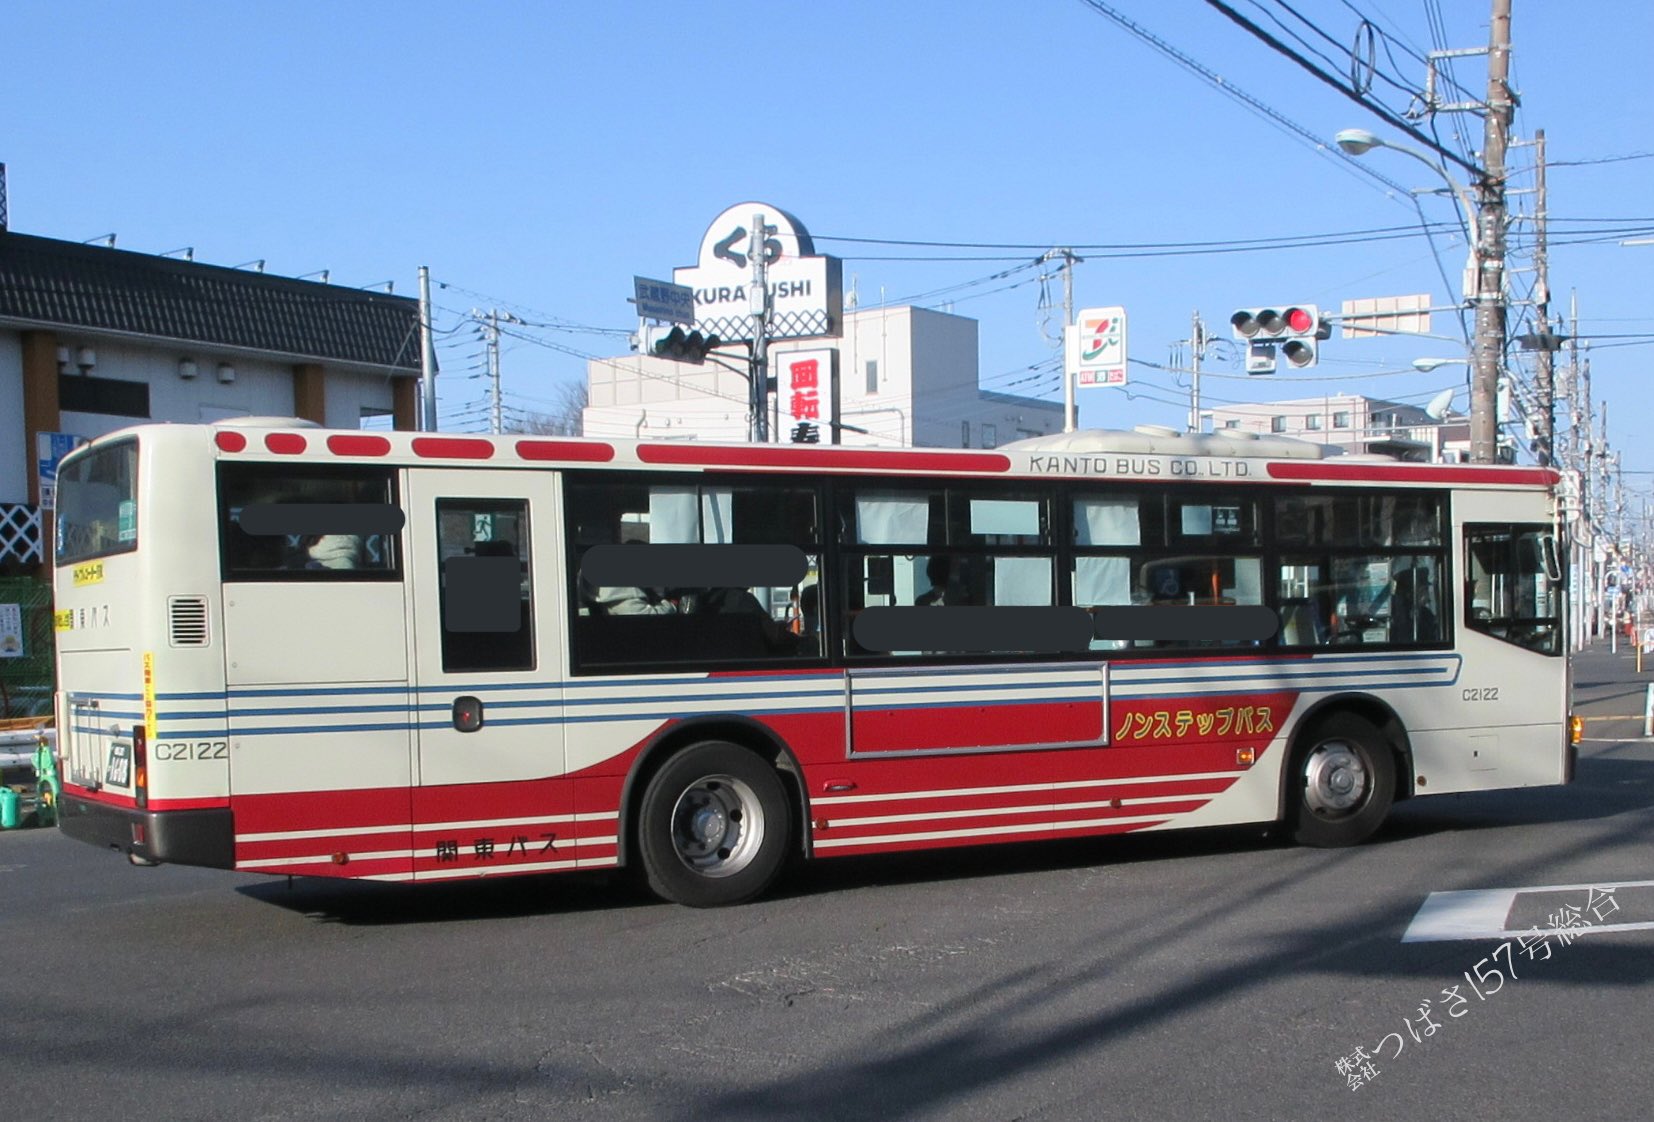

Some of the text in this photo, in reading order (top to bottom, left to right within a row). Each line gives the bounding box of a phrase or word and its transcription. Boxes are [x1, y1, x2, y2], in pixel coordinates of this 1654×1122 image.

[1029, 456, 1107, 473] KANTO
[1116, 458, 1161, 475] BUS
[1462, 687, 1499, 702] C2122
[1115, 706, 1274, 741] ノンステップバス
[155, 741, 229, 762] C2122
[436, 833, 559, 863] 関東バス
